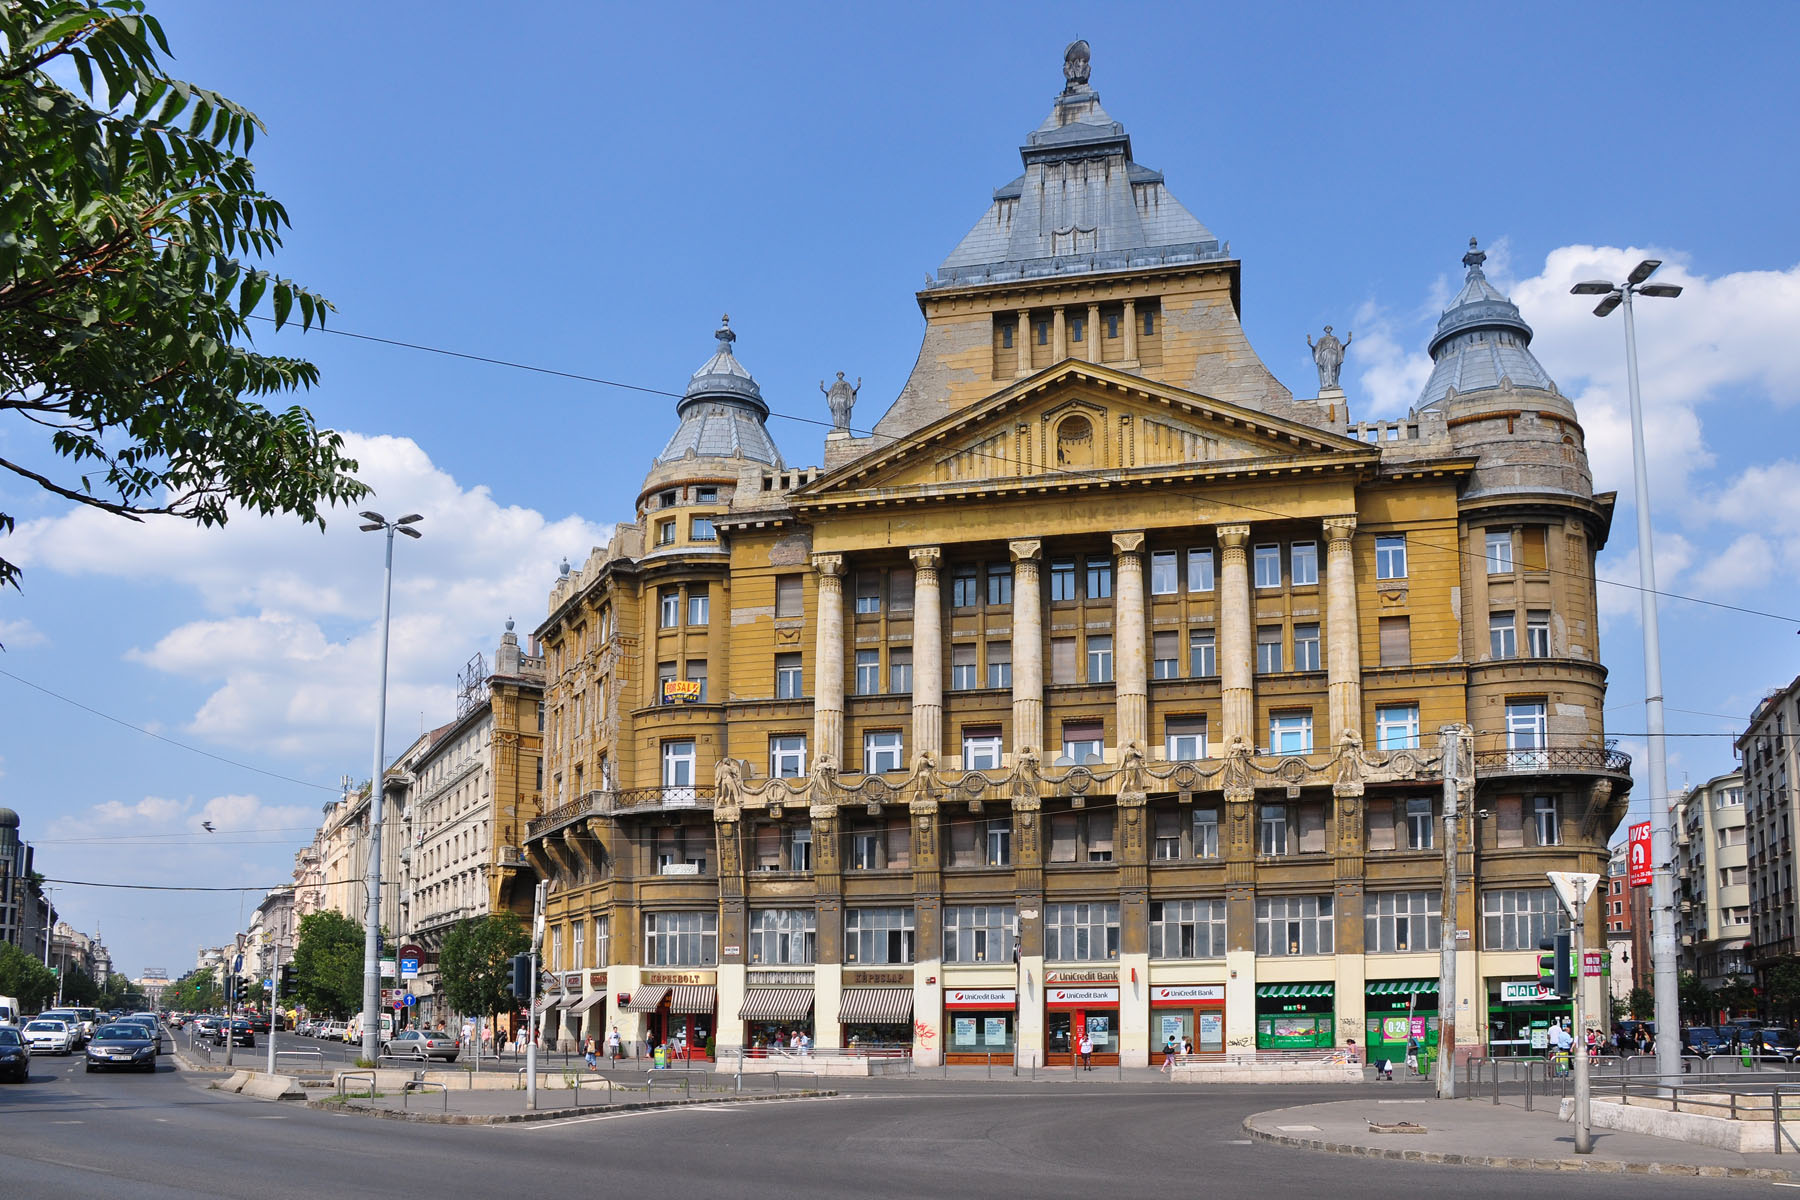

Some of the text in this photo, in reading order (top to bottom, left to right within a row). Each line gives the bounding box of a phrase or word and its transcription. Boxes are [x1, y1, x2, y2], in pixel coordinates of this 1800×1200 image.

[666, 682, 698, 694] FOR SALE
[1060, 971, 1119, 981] UniCredit Bank
[1283, 1003, 1306, 1012] MATCH
[1388, 1021, 1406, 1033] 0-24
